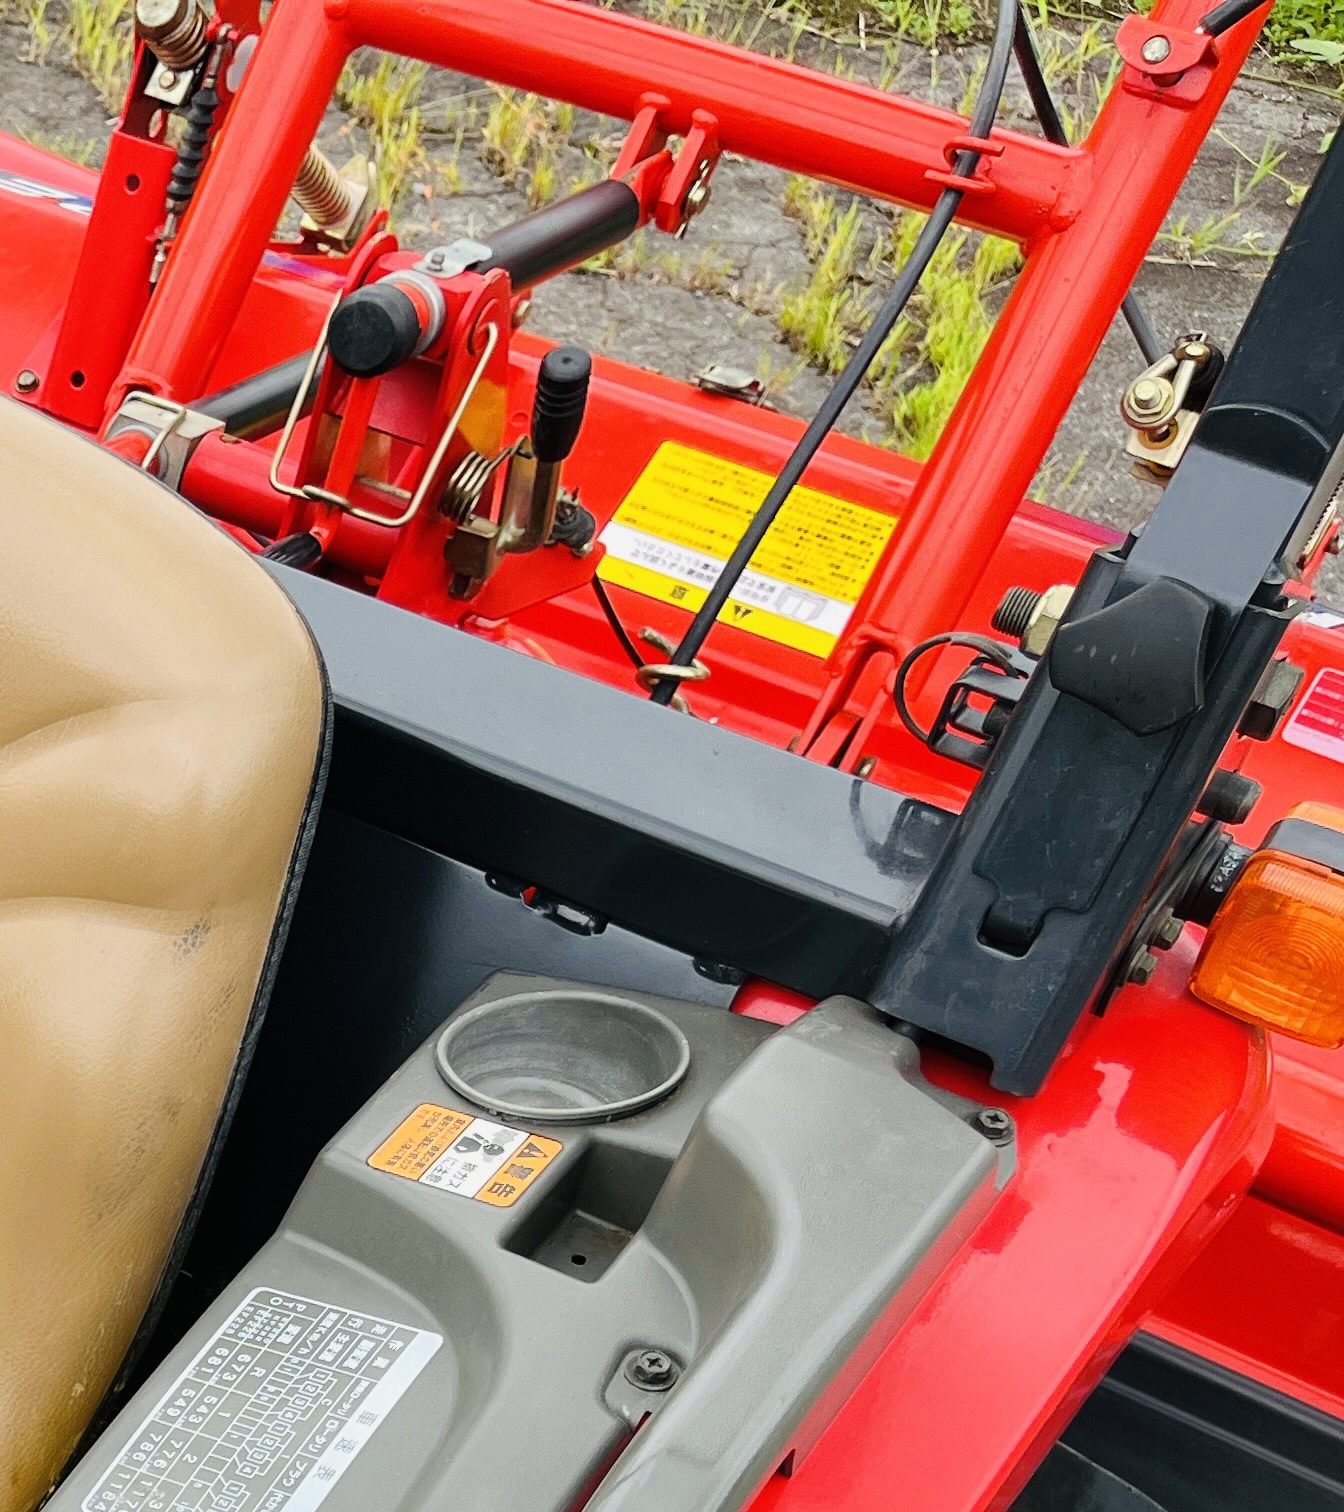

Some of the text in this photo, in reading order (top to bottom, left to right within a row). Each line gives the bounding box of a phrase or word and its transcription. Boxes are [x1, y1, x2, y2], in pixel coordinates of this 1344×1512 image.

[267, 1295, 308, 1313] PTO
[198, 1346, 231, 1374] 681
[218, 1352, 253, 1382] 673
[248, 1366, 267, 1378] R
[163, 1387, 197, 1417] 549
[185, 1394, 219, 1425] 543
[216, 1409, 232, 1418] 1
[319, 1397, 333, 1407] C
[129, 1431, 162, 1462] 786
[305, 1418, 340, 1453] ロータリ
[149, 1438, 184, 1469] 776
[180, 1452, 198, 1464] 2
[90, 1471, 133, 1512] 1184
[145, 1498, 164, 1510] 3
